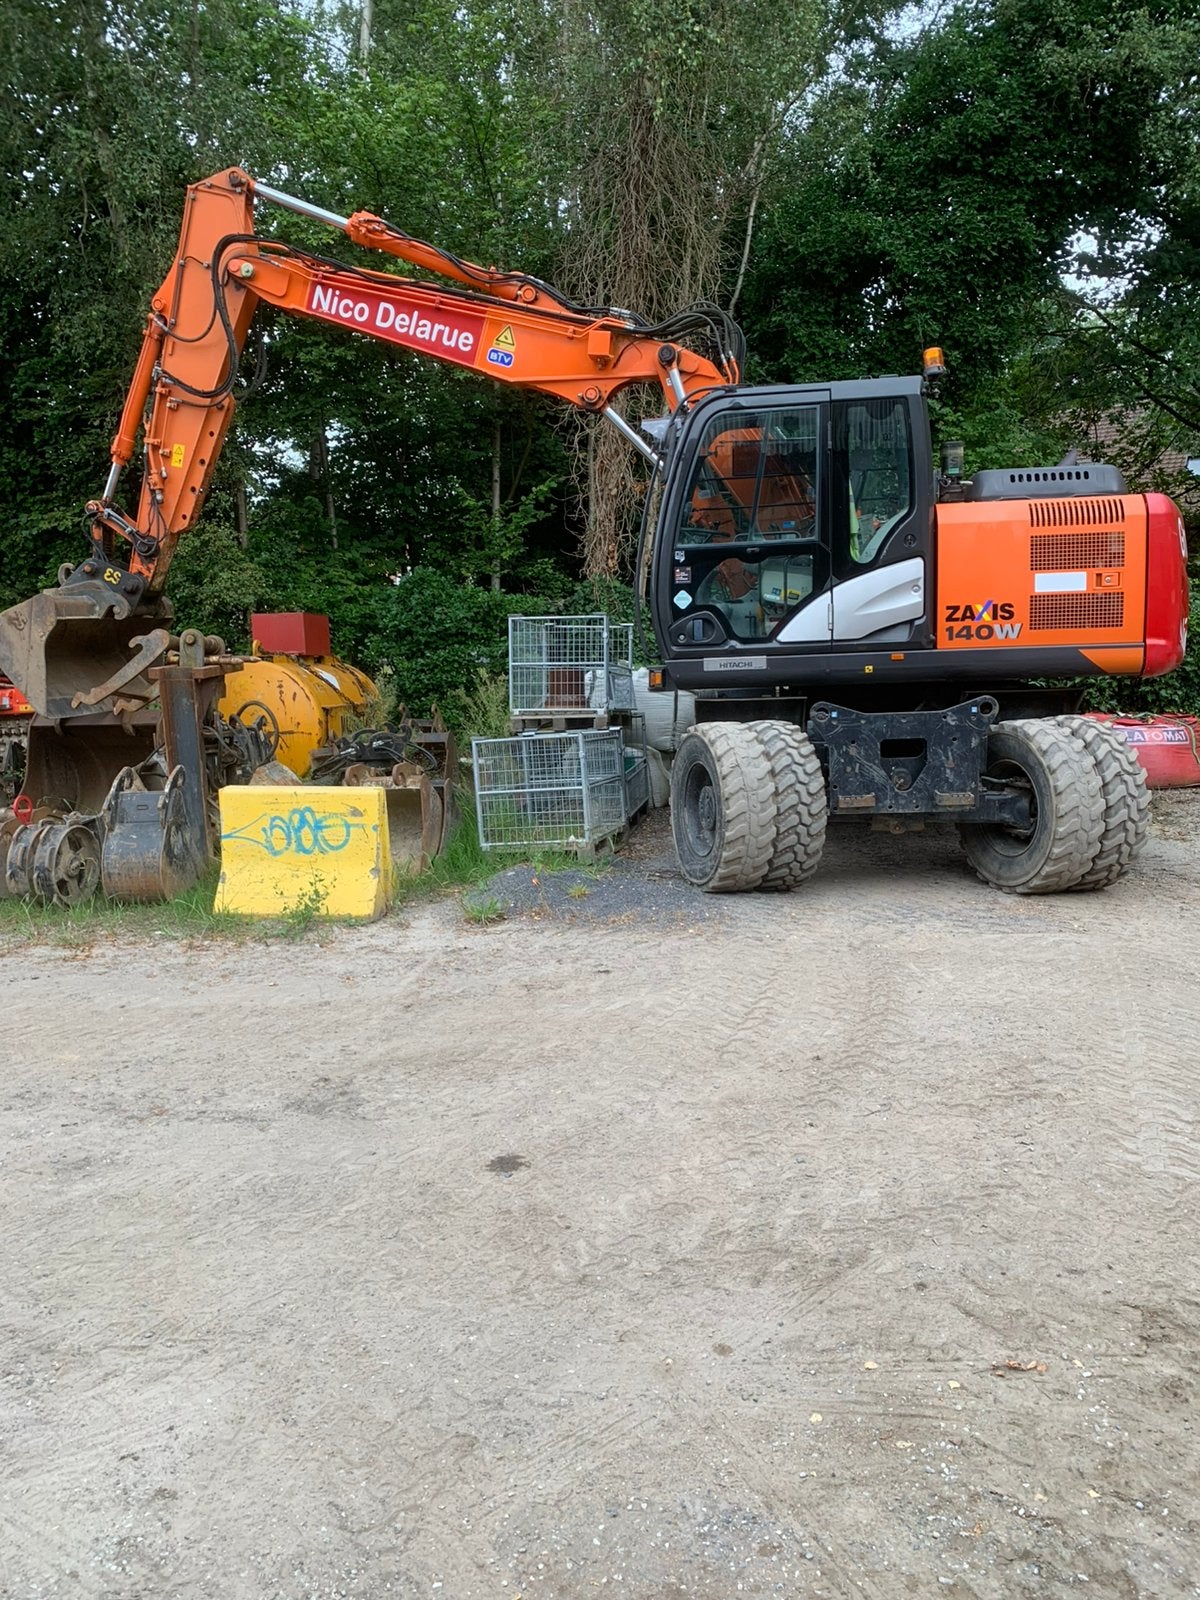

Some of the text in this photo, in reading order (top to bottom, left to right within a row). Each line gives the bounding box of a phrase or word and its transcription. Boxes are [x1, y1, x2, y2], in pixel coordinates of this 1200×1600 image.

[311, 285, 474, 352] Nico Delarue
[490, 351, 512, 364] BTV
[945, 600, 1015, 622] ZAXIS
[945, 623, 1023, 641] 140W
[719, 661, 753, 669] HITACHI
